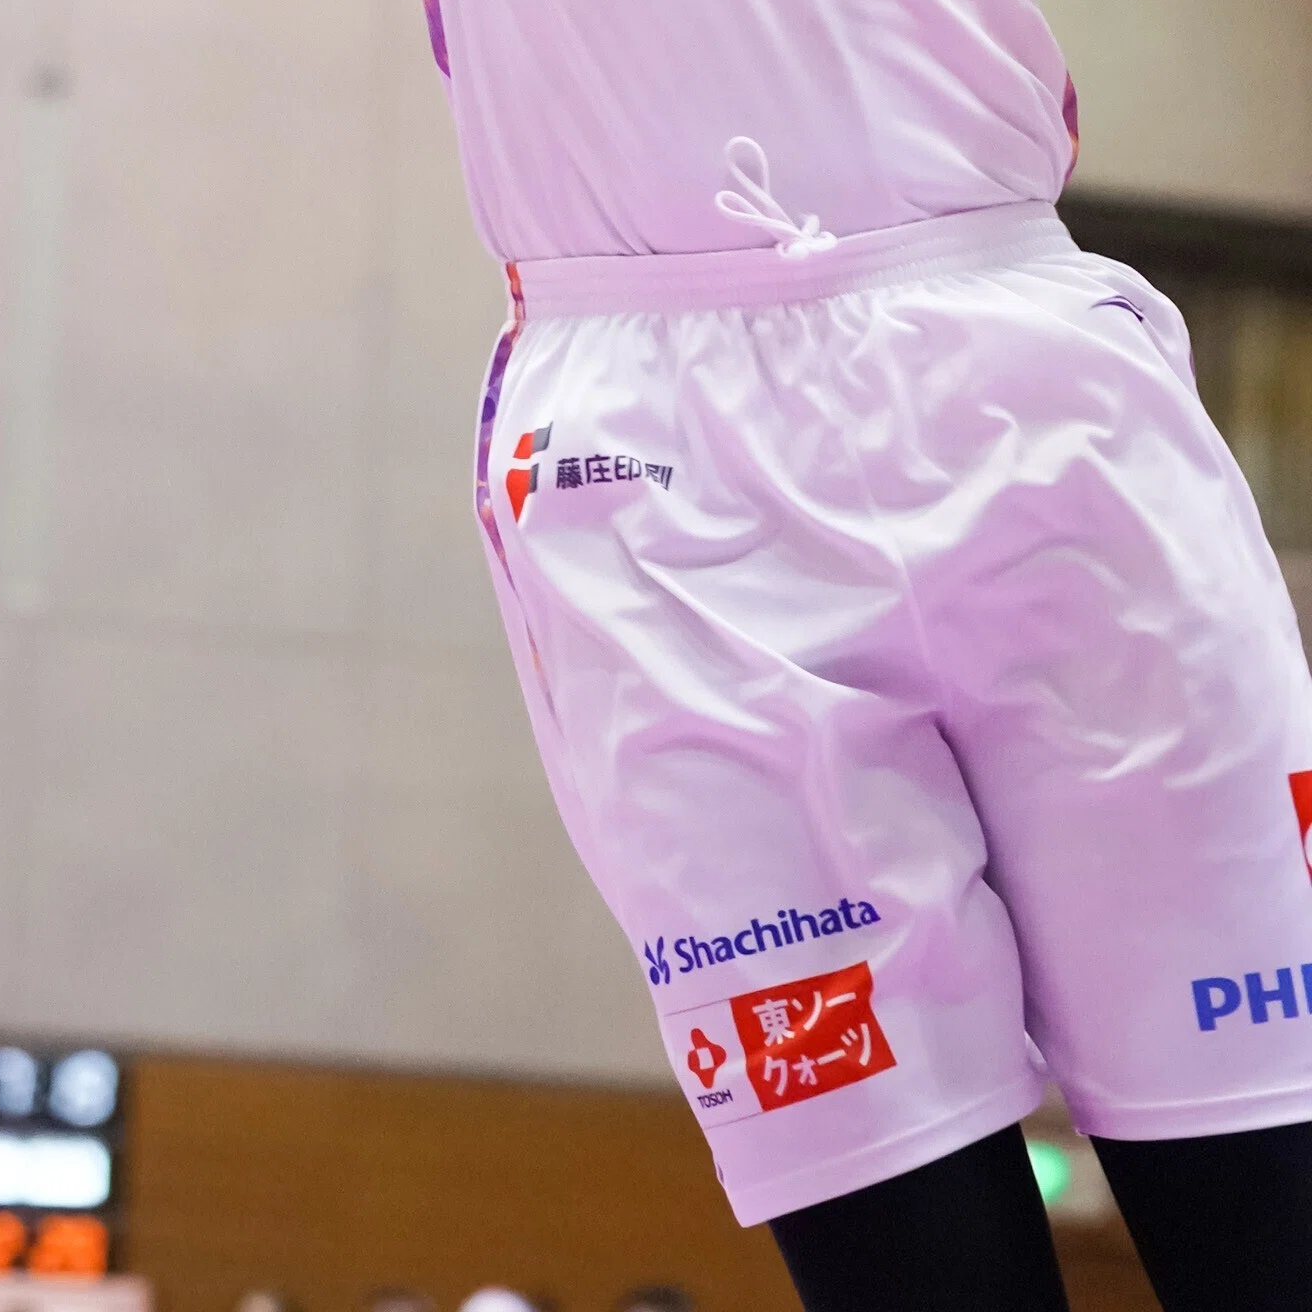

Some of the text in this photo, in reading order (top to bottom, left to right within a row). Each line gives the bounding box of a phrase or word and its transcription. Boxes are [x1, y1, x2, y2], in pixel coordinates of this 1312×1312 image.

[674, 898, 881, 974] Shachihata
[751, 990, 857, 1048] 東ソー
[763, 1022, 872, 1097] クォーツ
[697, 1088, 734, 1110] TOSOH
